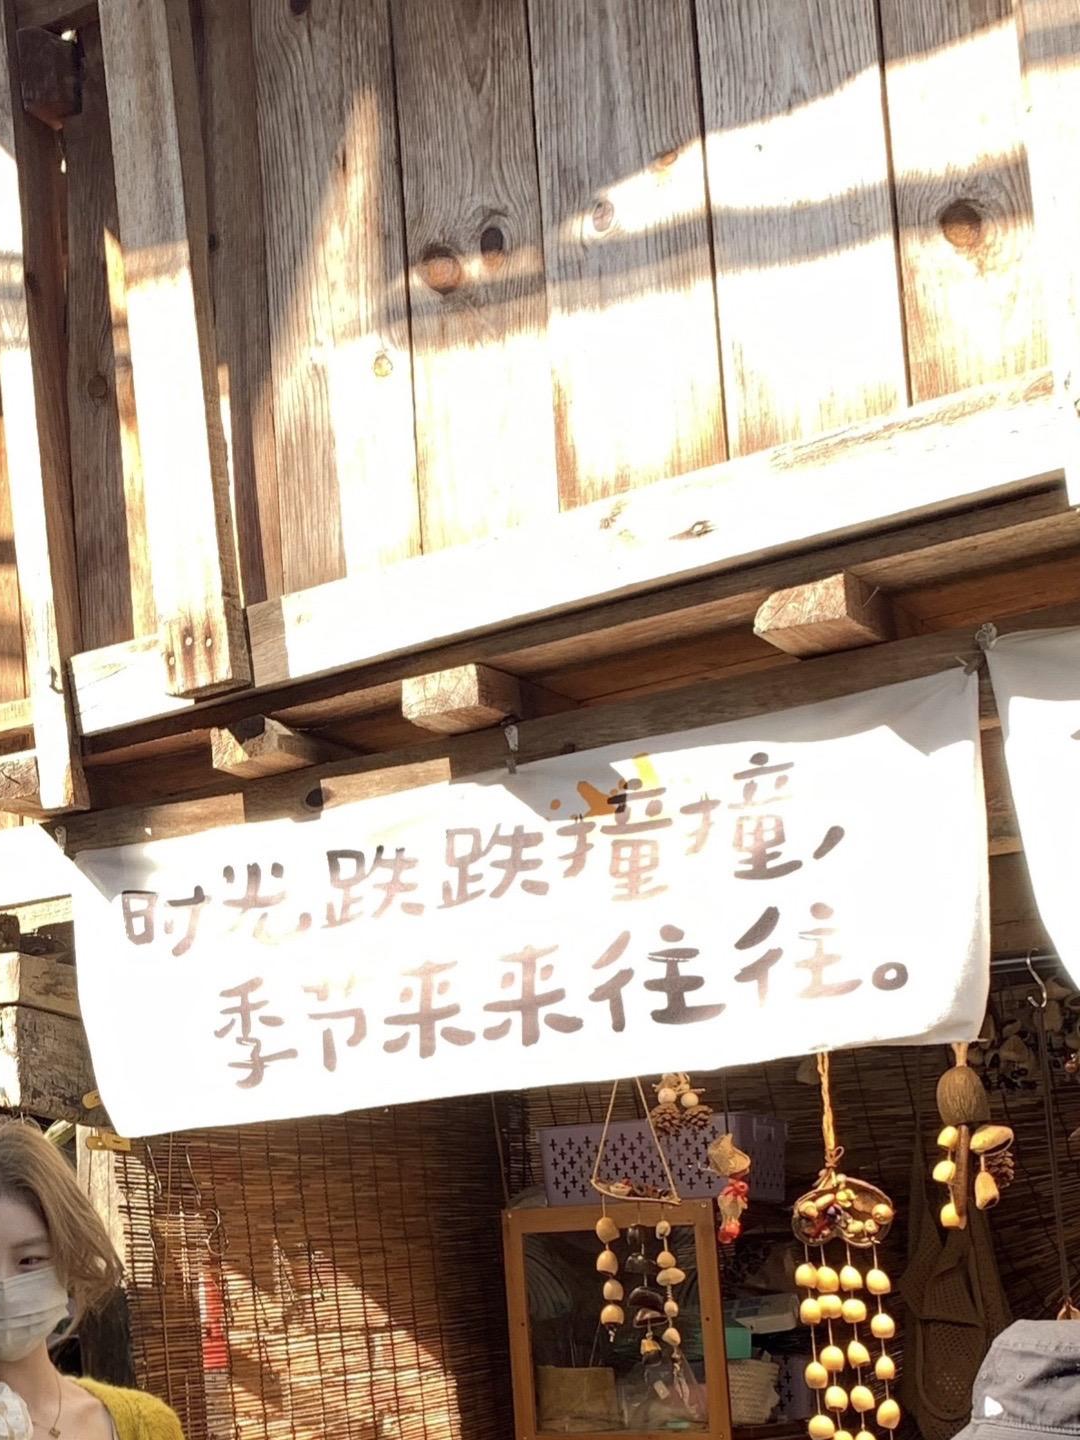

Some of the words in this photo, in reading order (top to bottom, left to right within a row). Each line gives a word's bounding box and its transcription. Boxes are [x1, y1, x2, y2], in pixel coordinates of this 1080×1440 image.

[214, 902, 909, 1089] 季节来来往往。
